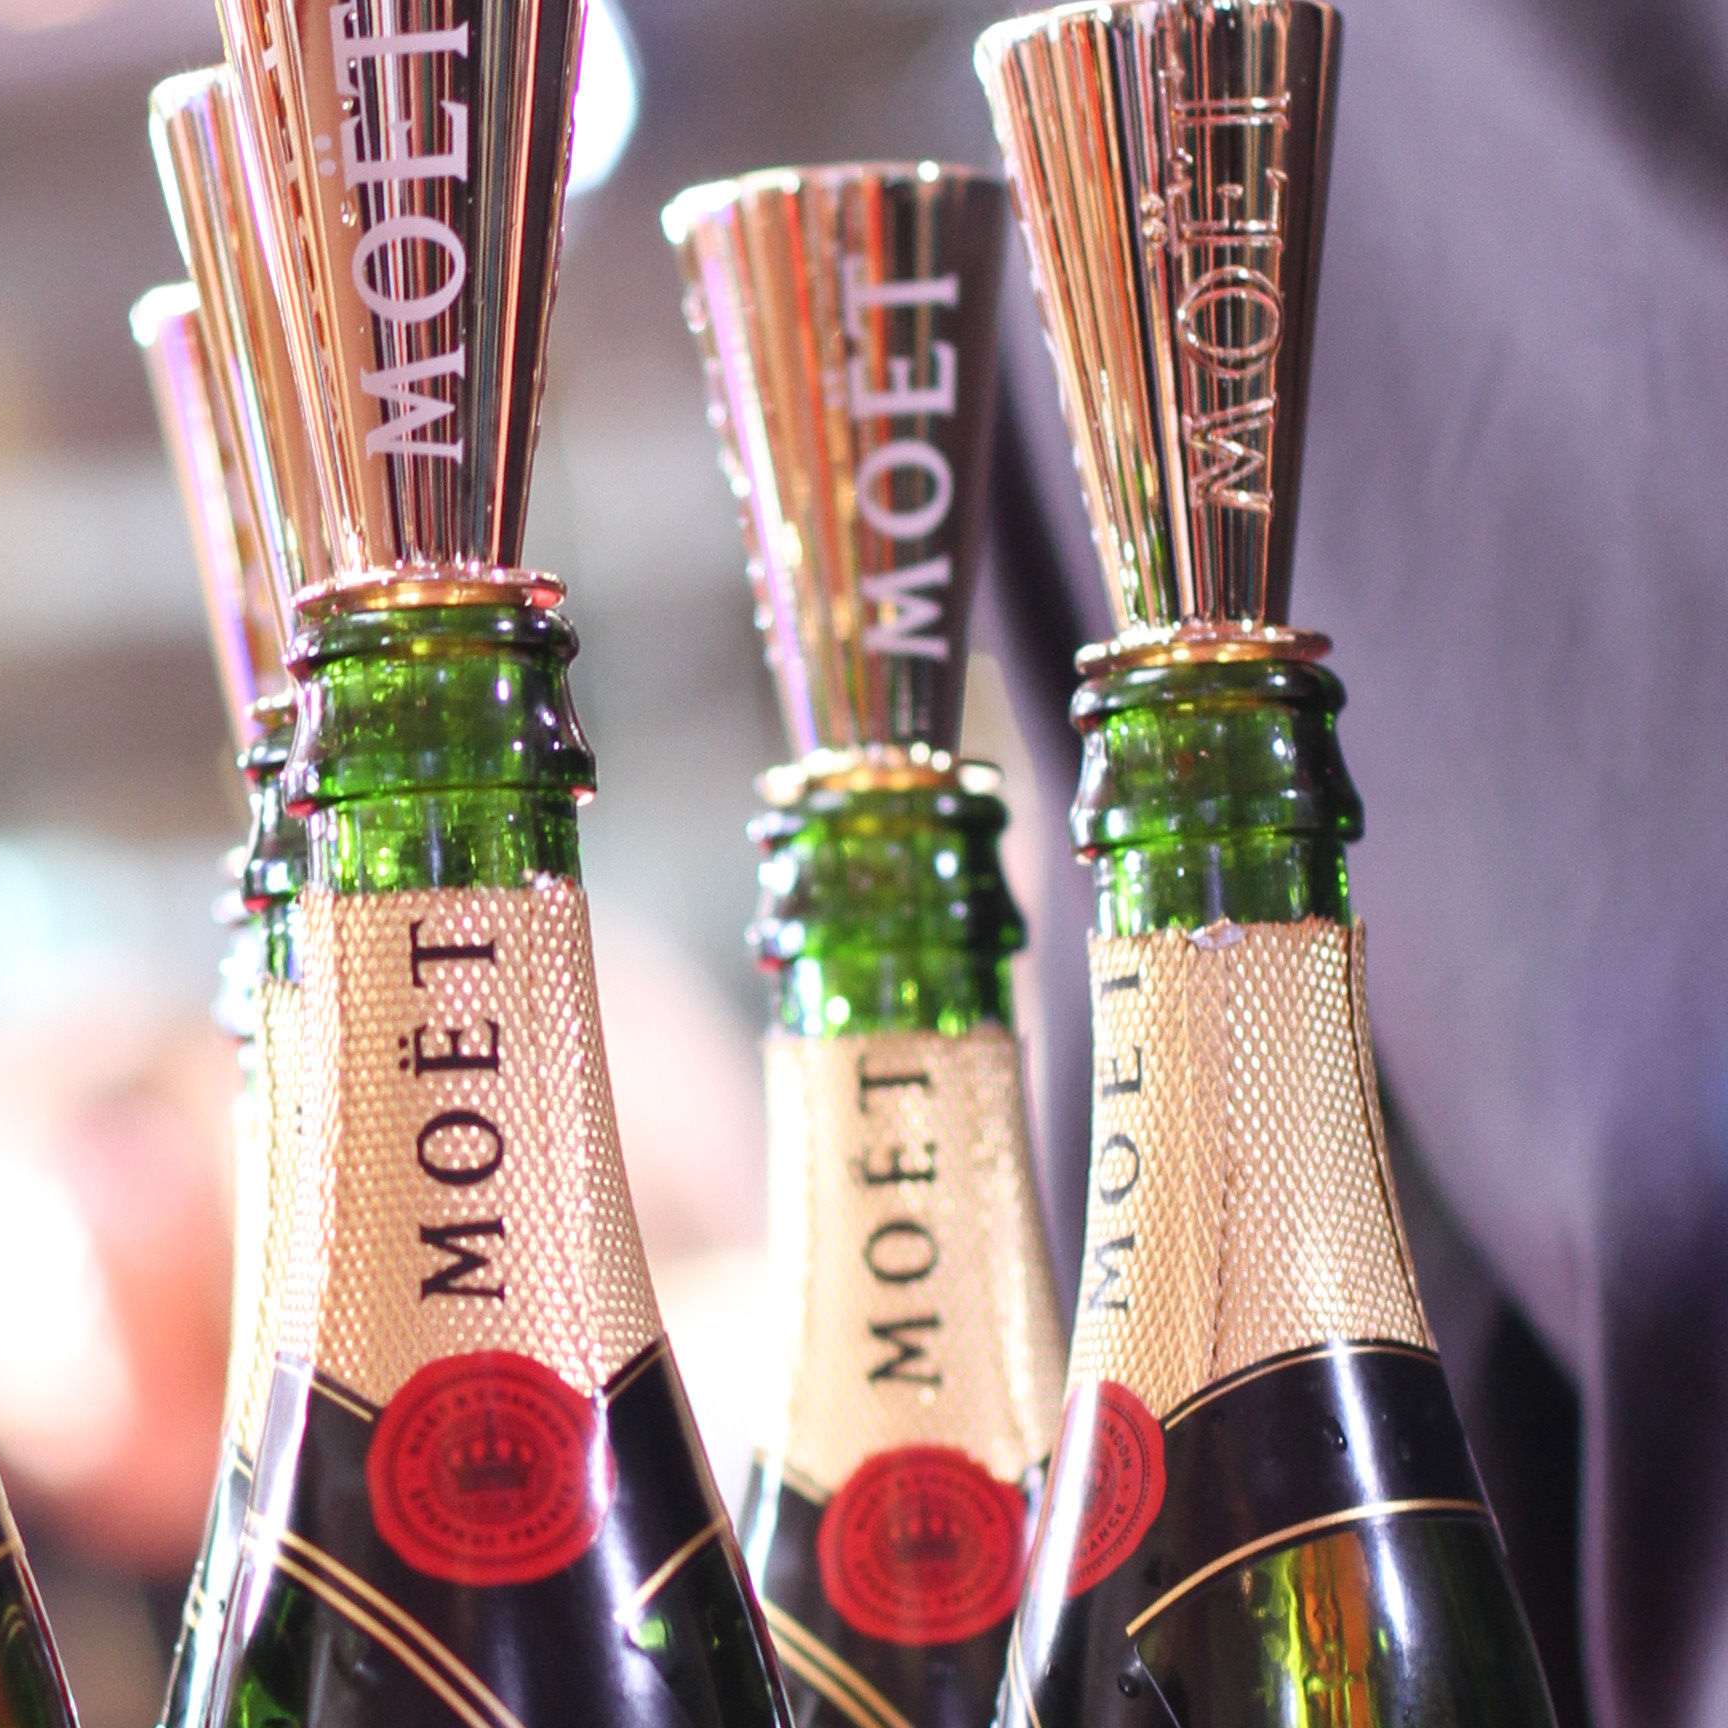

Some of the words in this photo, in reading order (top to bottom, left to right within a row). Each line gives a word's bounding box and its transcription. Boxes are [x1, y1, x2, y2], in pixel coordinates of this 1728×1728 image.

[313, 2, 470, 465] MOËT
[1140, 52, 1291, 515] MOËT
[398, 918, 504, 1302] MOËT
